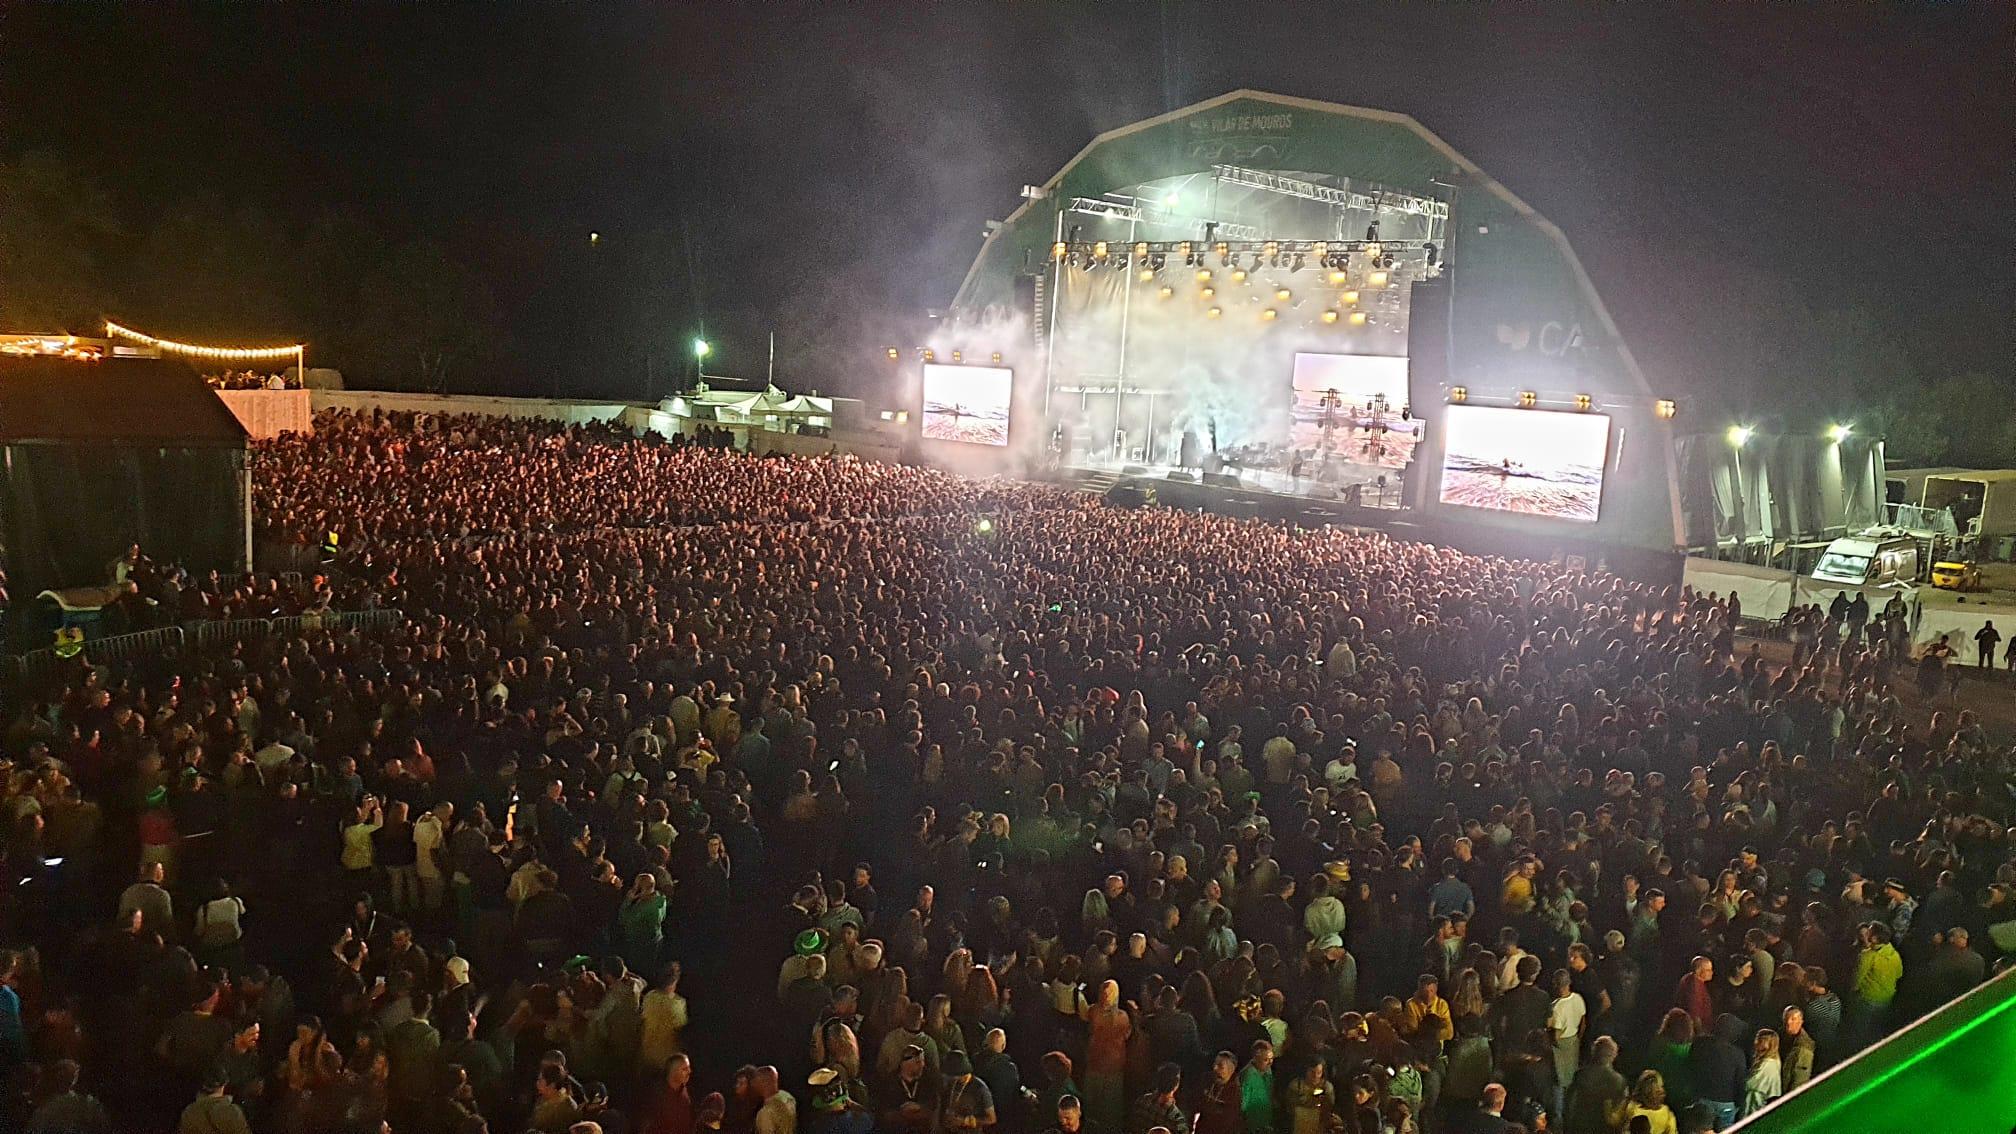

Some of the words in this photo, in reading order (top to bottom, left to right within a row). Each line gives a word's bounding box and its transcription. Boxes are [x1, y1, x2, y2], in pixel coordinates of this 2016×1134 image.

[1239, 116, 1250, 130] DE
[1252, 114, 1292, 129] MOUROS
[1539, 320, 1588, 357] CA
